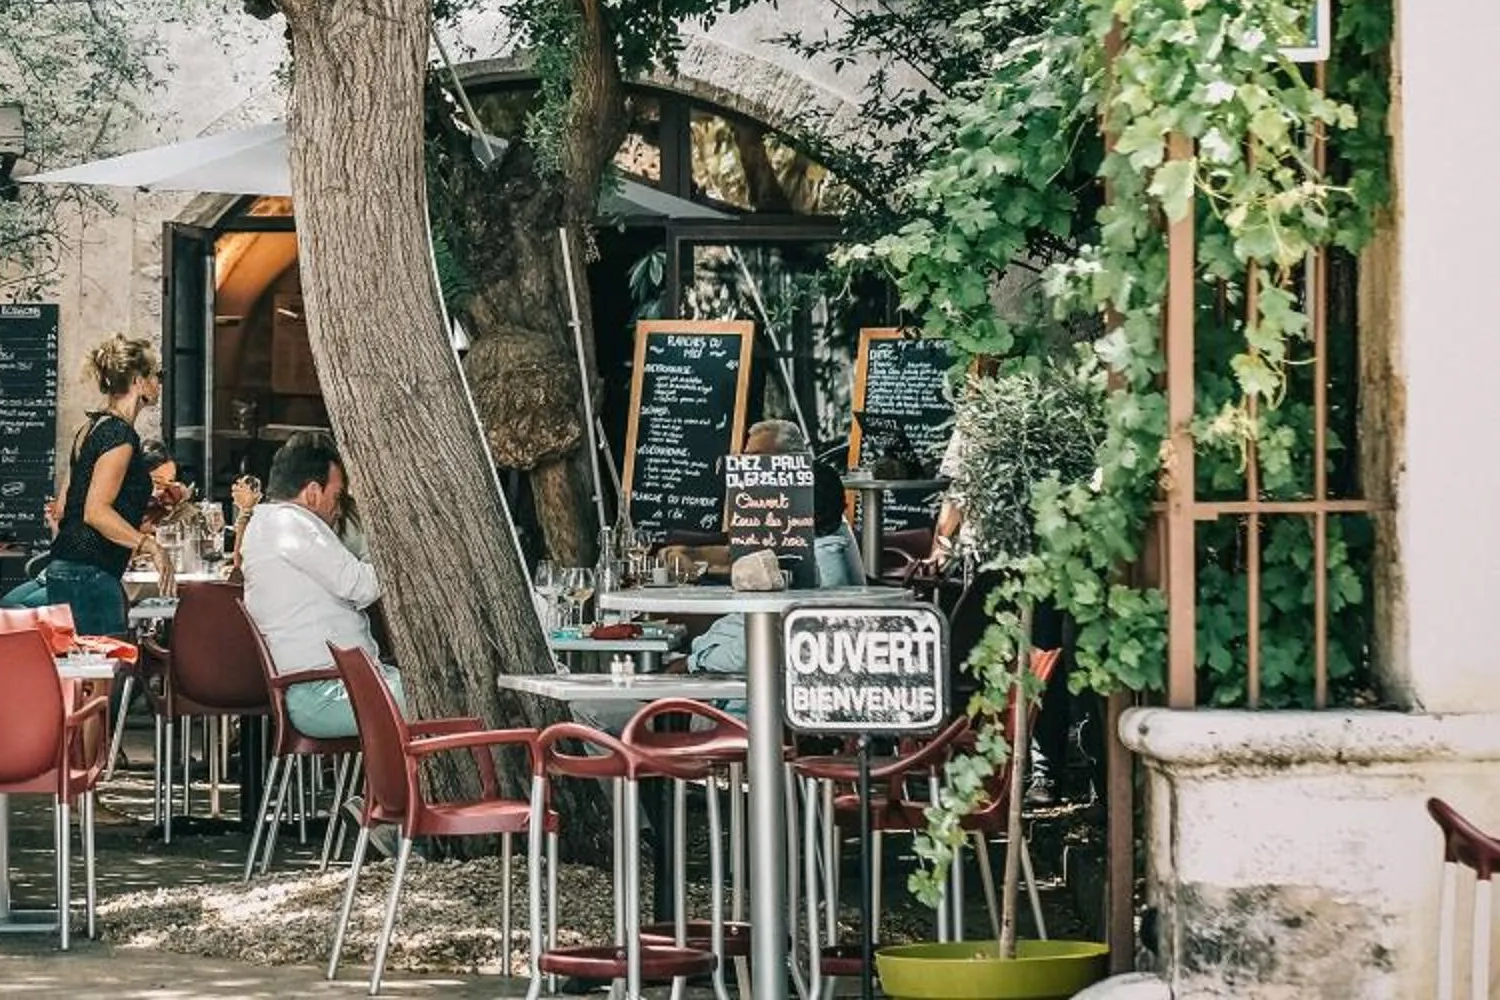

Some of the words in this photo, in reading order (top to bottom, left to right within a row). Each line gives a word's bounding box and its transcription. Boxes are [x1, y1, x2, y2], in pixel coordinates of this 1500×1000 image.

[725, 455, 762, 471] CHEZ
[771, 455, 811, 471] PAUL
[791, 630, 935, 675] OUVERT
[792, 685, 936, 713] BIENVENUE
